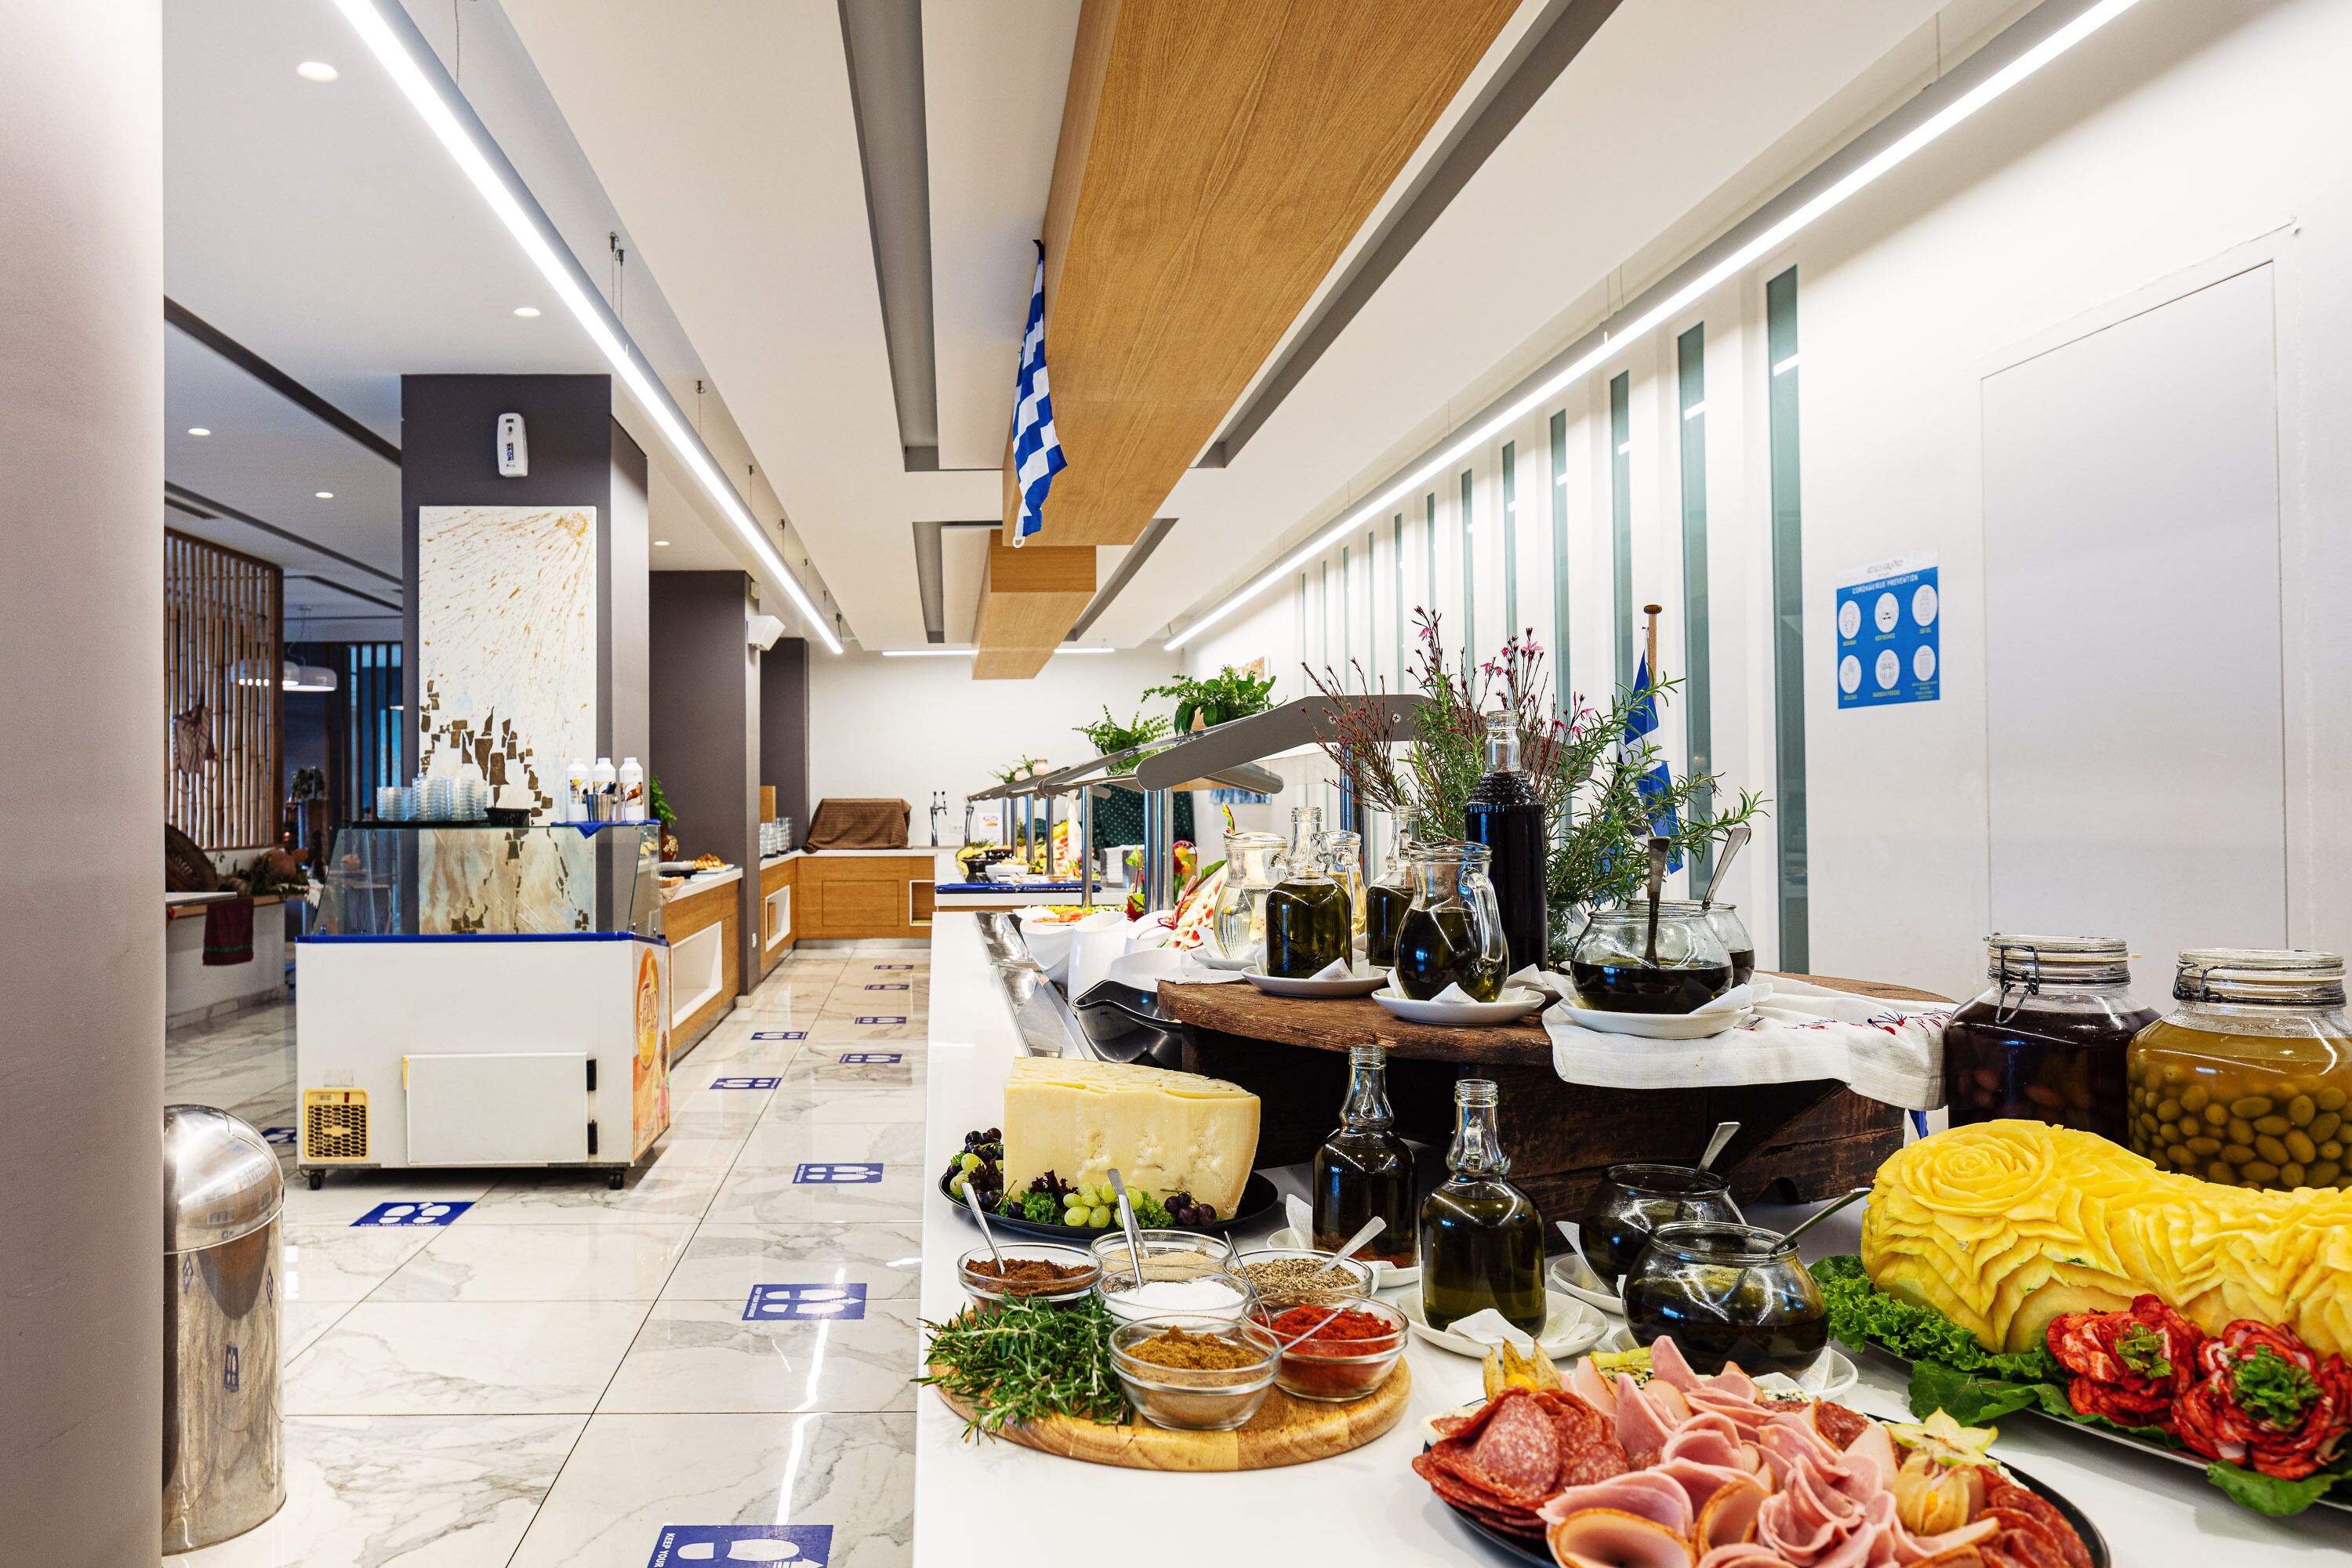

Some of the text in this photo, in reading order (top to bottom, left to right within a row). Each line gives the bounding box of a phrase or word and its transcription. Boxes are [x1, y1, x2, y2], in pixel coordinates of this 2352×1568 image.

[1852, 581, 1886, 594] CORONAVIRUS
[654, 1533, 676, 1568] KEEP YOUR
